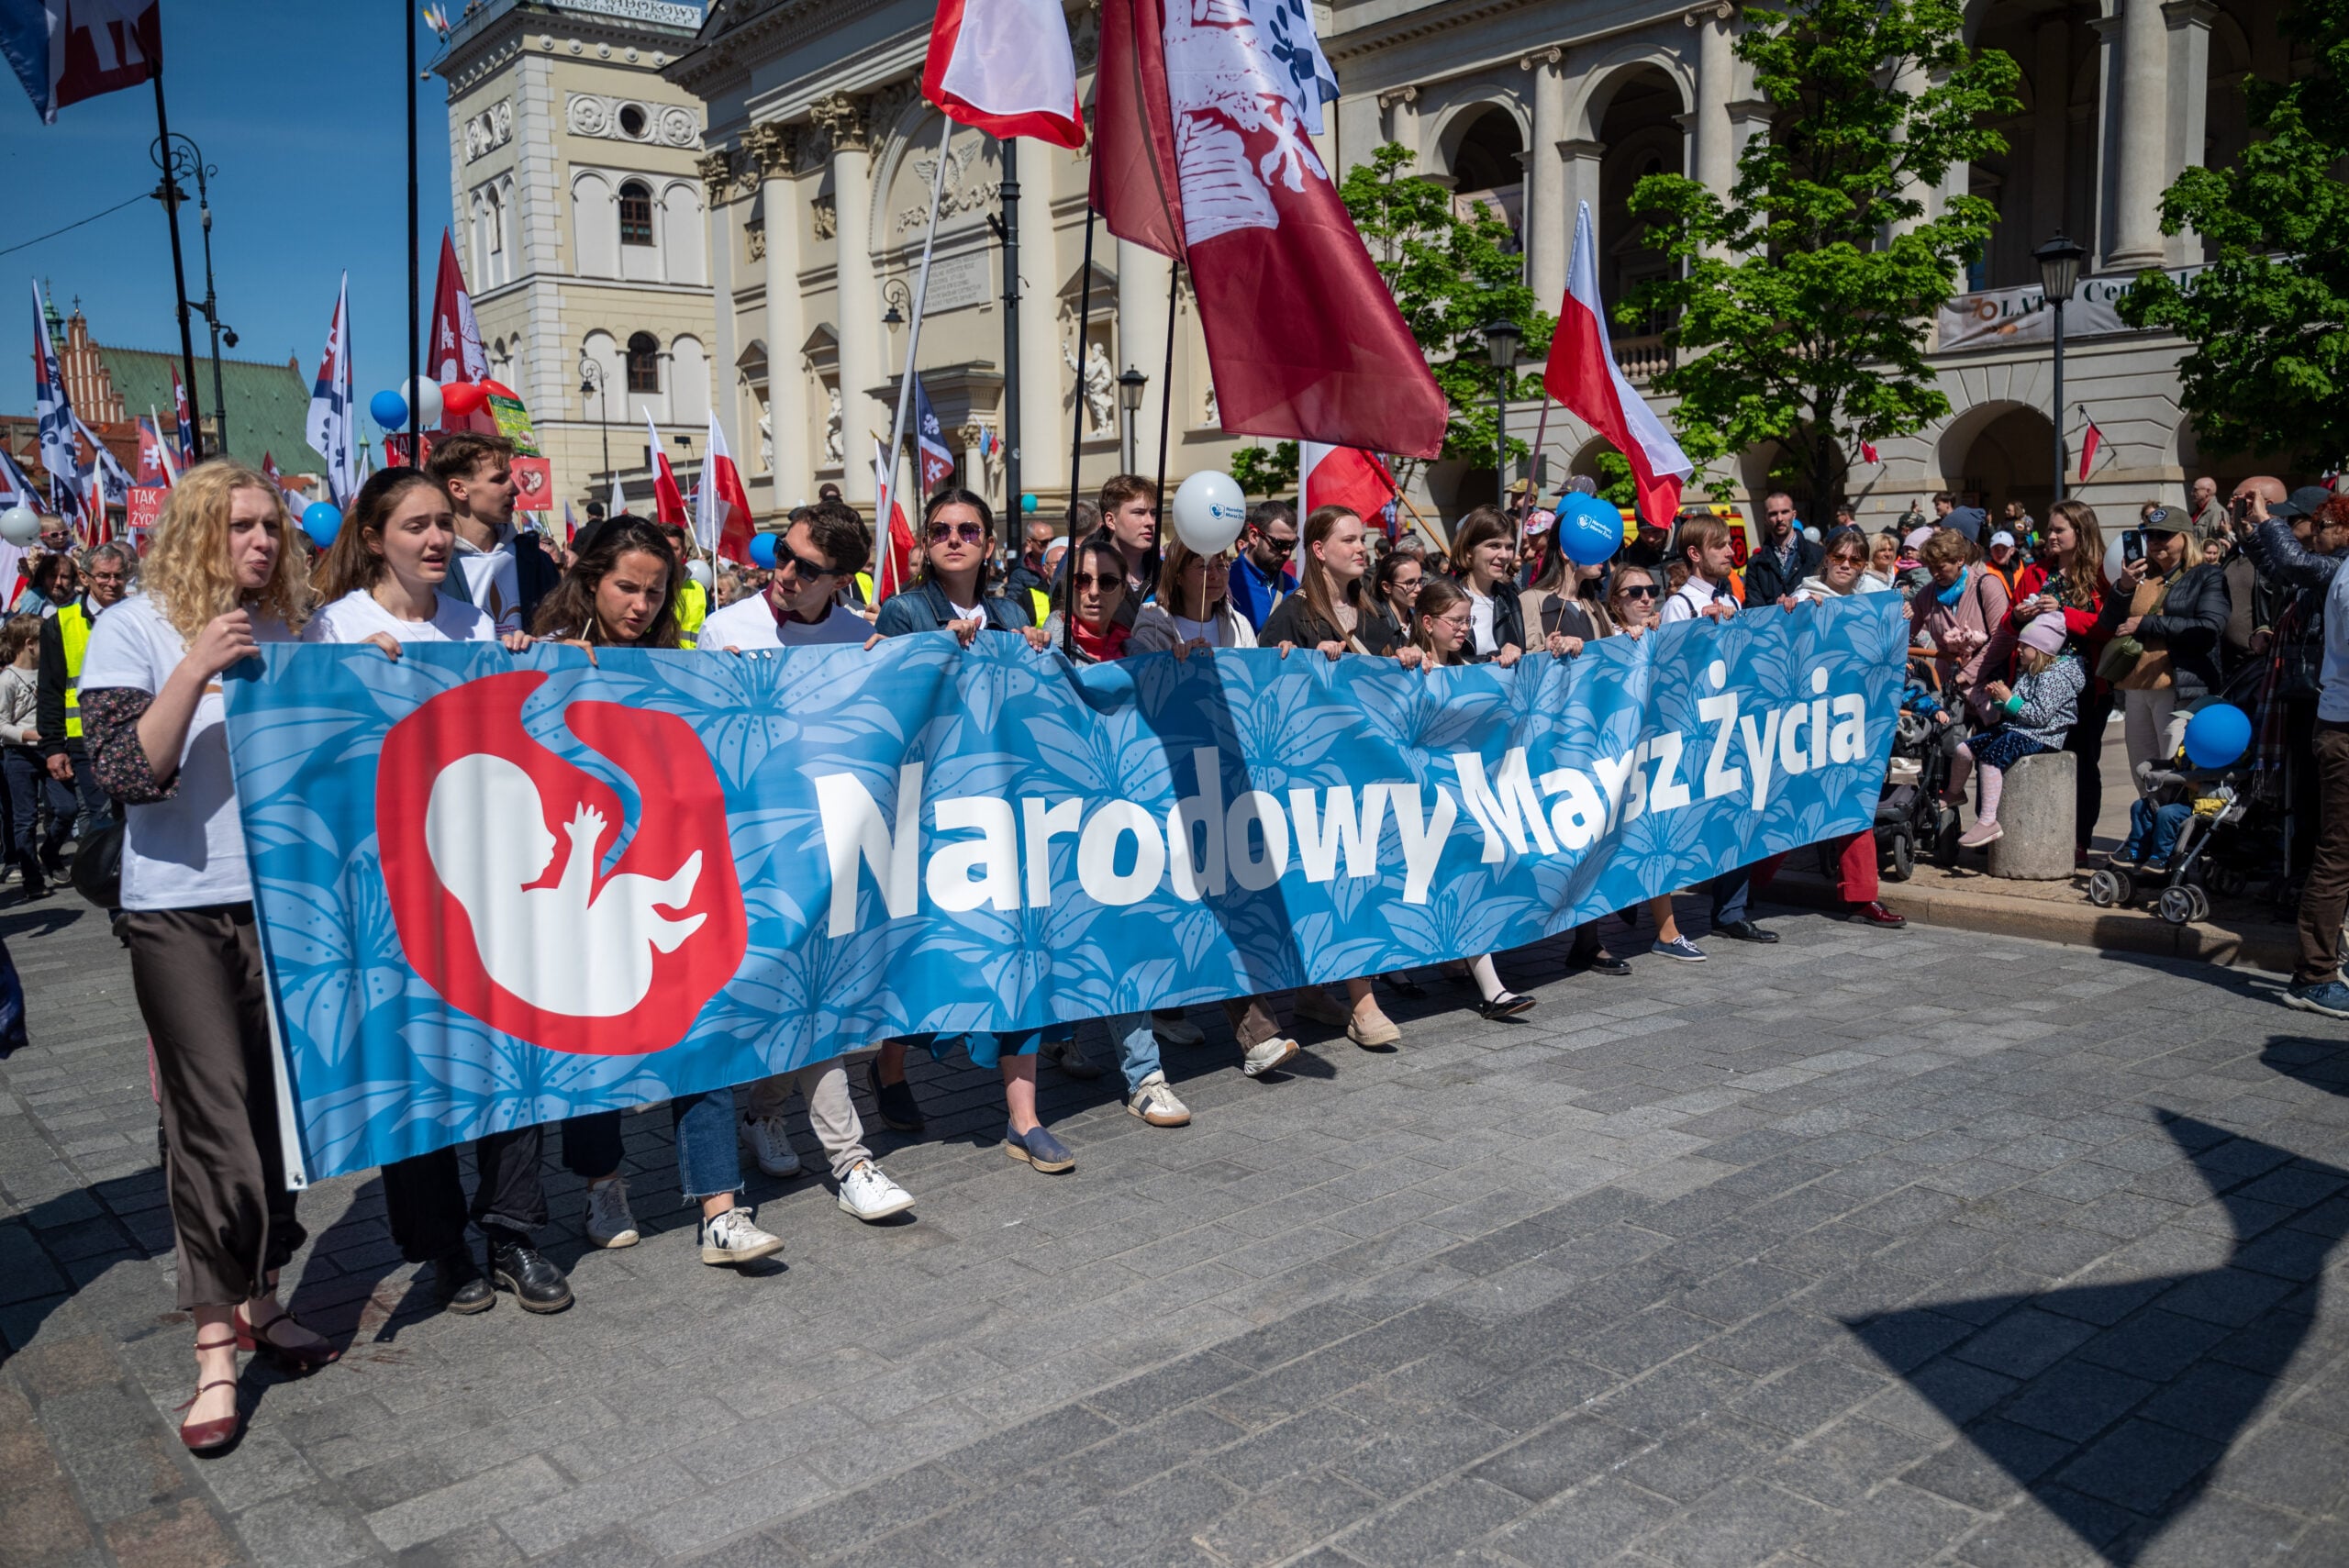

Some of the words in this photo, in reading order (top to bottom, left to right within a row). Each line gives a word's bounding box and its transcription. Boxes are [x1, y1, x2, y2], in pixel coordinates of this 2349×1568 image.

[1970, 297, 1998, 321] 70
[132, 489, 157, 506] TAK
[815, 746, 1457, 940] Narodowy
[1453, 730, 1691, 864] Marsz
[1698, 660, 1866, 812] Życia
